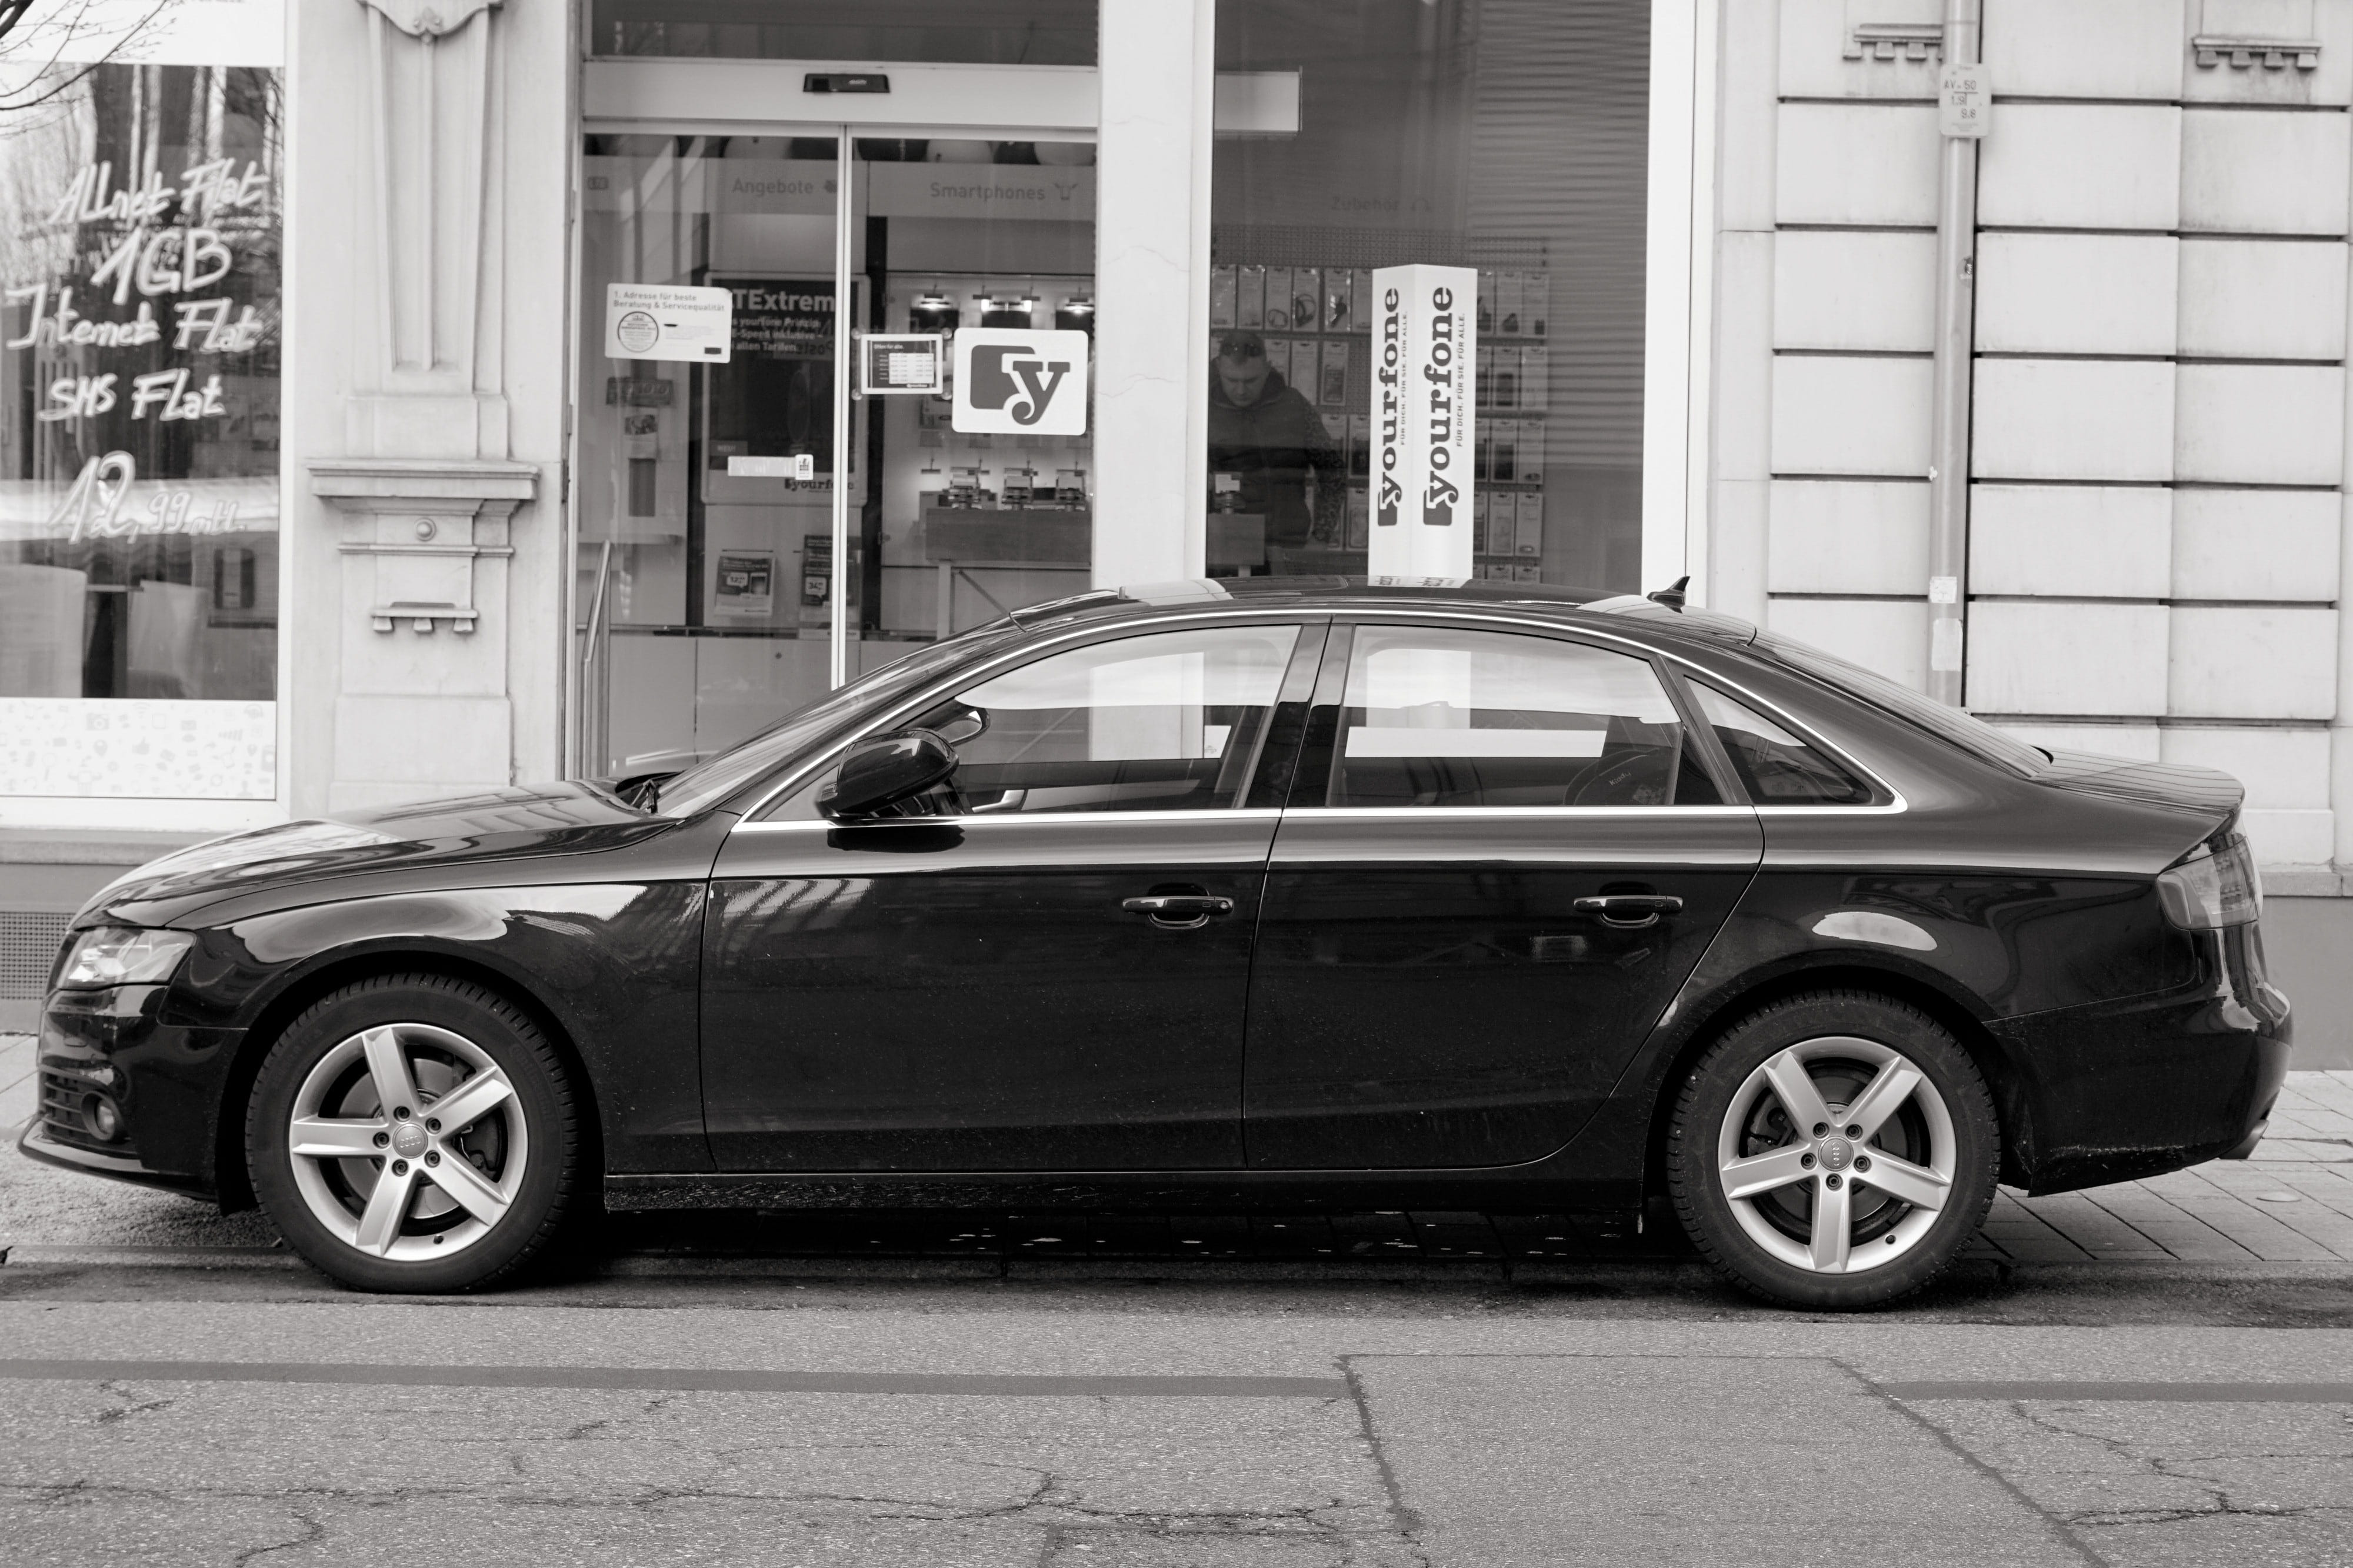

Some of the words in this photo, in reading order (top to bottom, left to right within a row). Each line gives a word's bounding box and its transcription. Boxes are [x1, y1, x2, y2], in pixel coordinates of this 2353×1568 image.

[732, 178, 814, 196] Angebote
[930, 182, 1045, 202] Smartphones
[90, 226, 233, 305] 1GB
[614, 300, 651, 309] Beratung
[662, 302, 725, 311] Servicequalität
[624, 292, 657, 300] Adresse
[732, 288, 835, 312] TExtrem
[5, 283, 162, 350] Internet
[36, 372, 118, 422] SMS
[1379, 288, 1402, 503] yourfone
[1424, 287, 1458, 503] yourfone
[1609, 771, 1632, 786] kiddy
